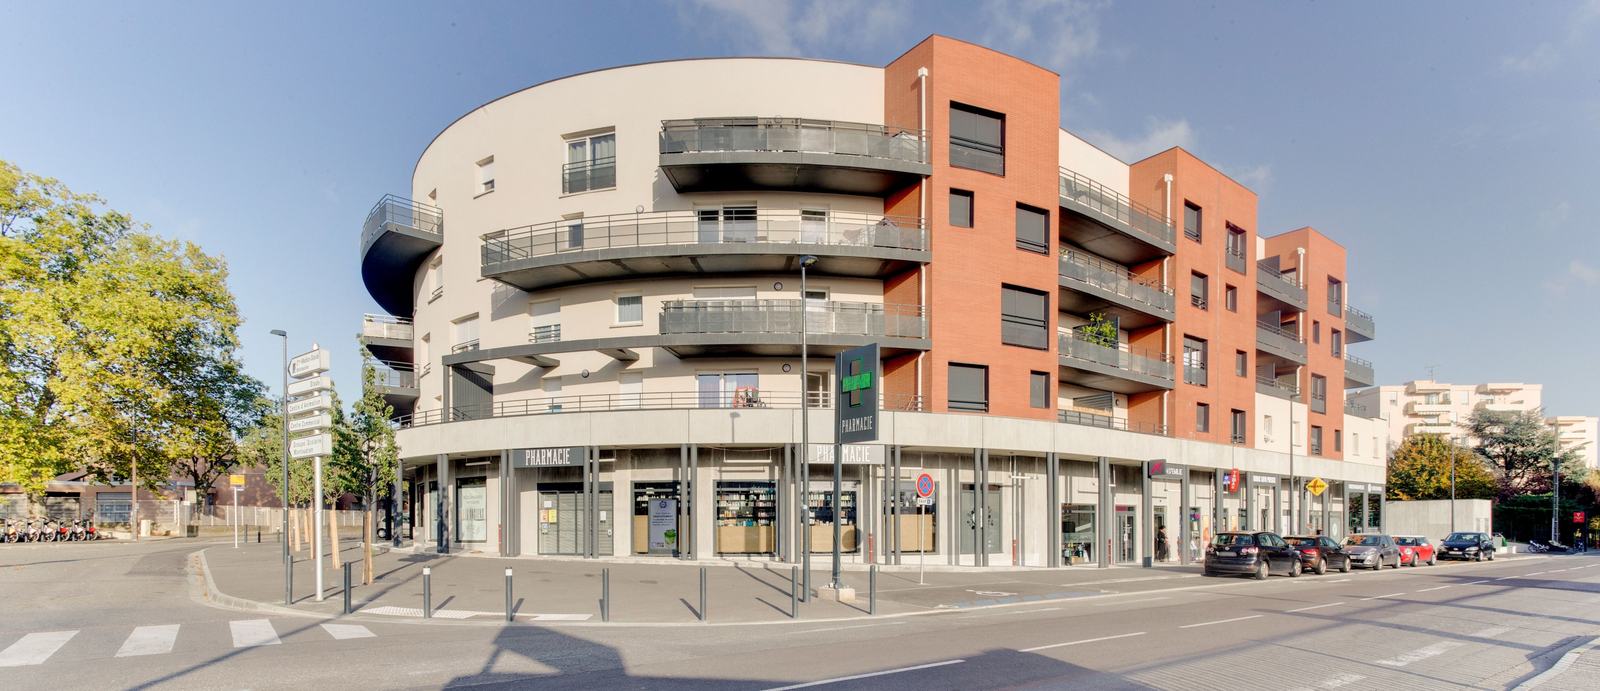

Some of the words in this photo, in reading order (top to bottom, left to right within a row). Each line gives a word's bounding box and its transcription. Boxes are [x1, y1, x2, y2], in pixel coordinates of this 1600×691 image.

[842, 415, 873, 433] PHARMACIE
[525, 447, 571, 466] PHARMACIE
[816, 445, 871, 462] PHAMACIE
